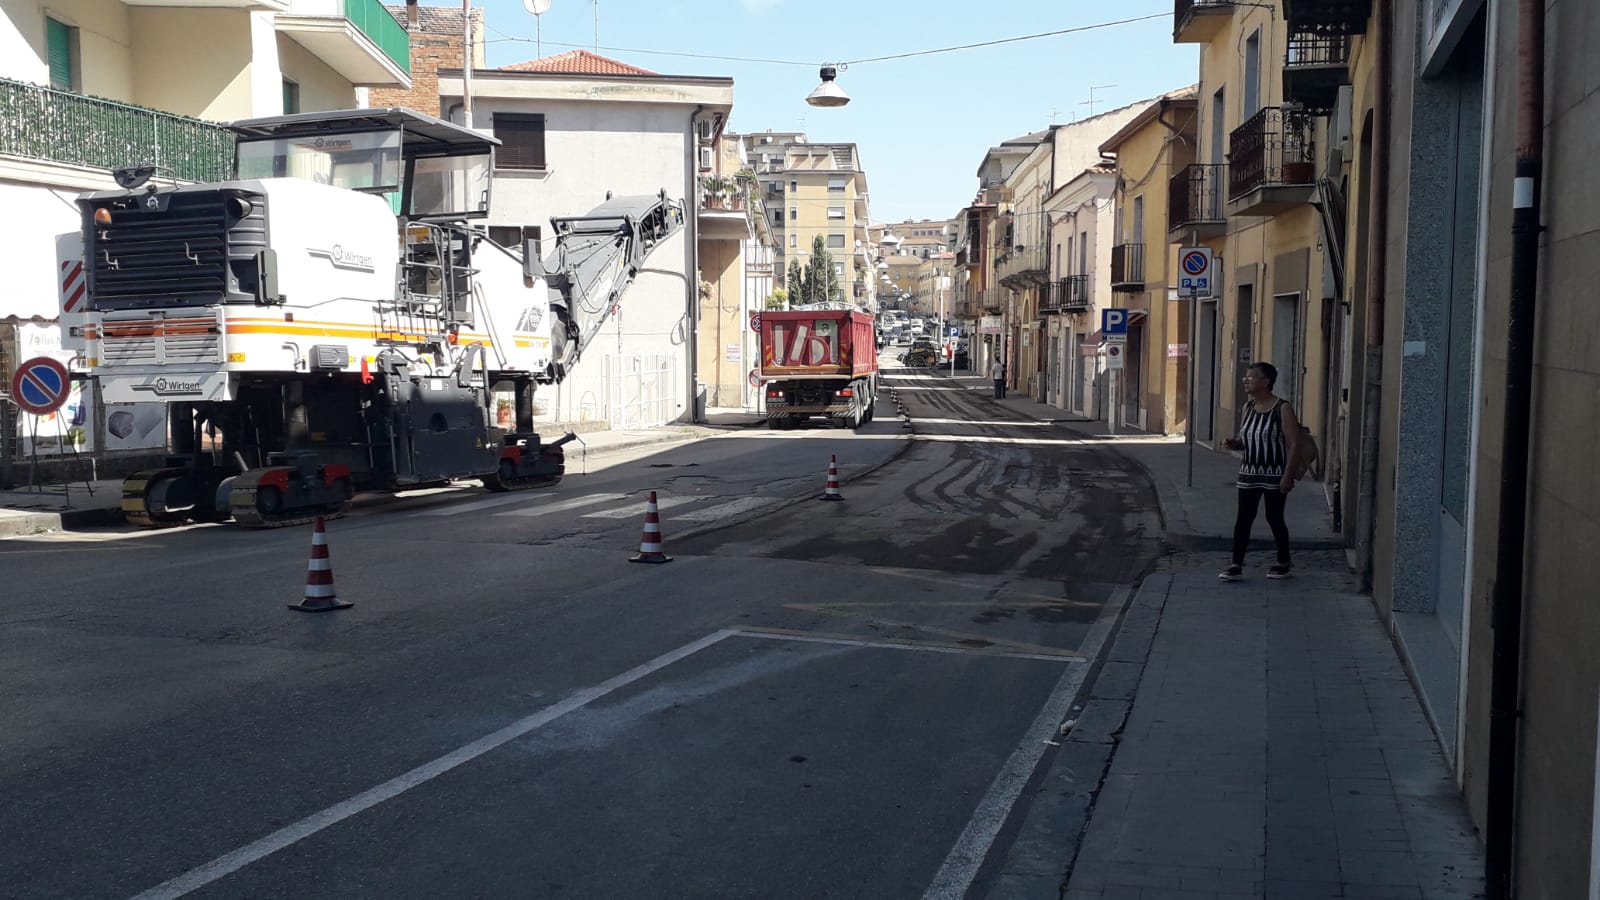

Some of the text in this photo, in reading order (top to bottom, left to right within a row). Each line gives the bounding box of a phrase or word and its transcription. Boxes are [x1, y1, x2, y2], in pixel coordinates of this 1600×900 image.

[344, 250, 373, 265] Wirtgen
[1106, 311, 1122, 331] P
[951, 328, 957, 336] P
[169, 382, 200, 391] Wirtgen
